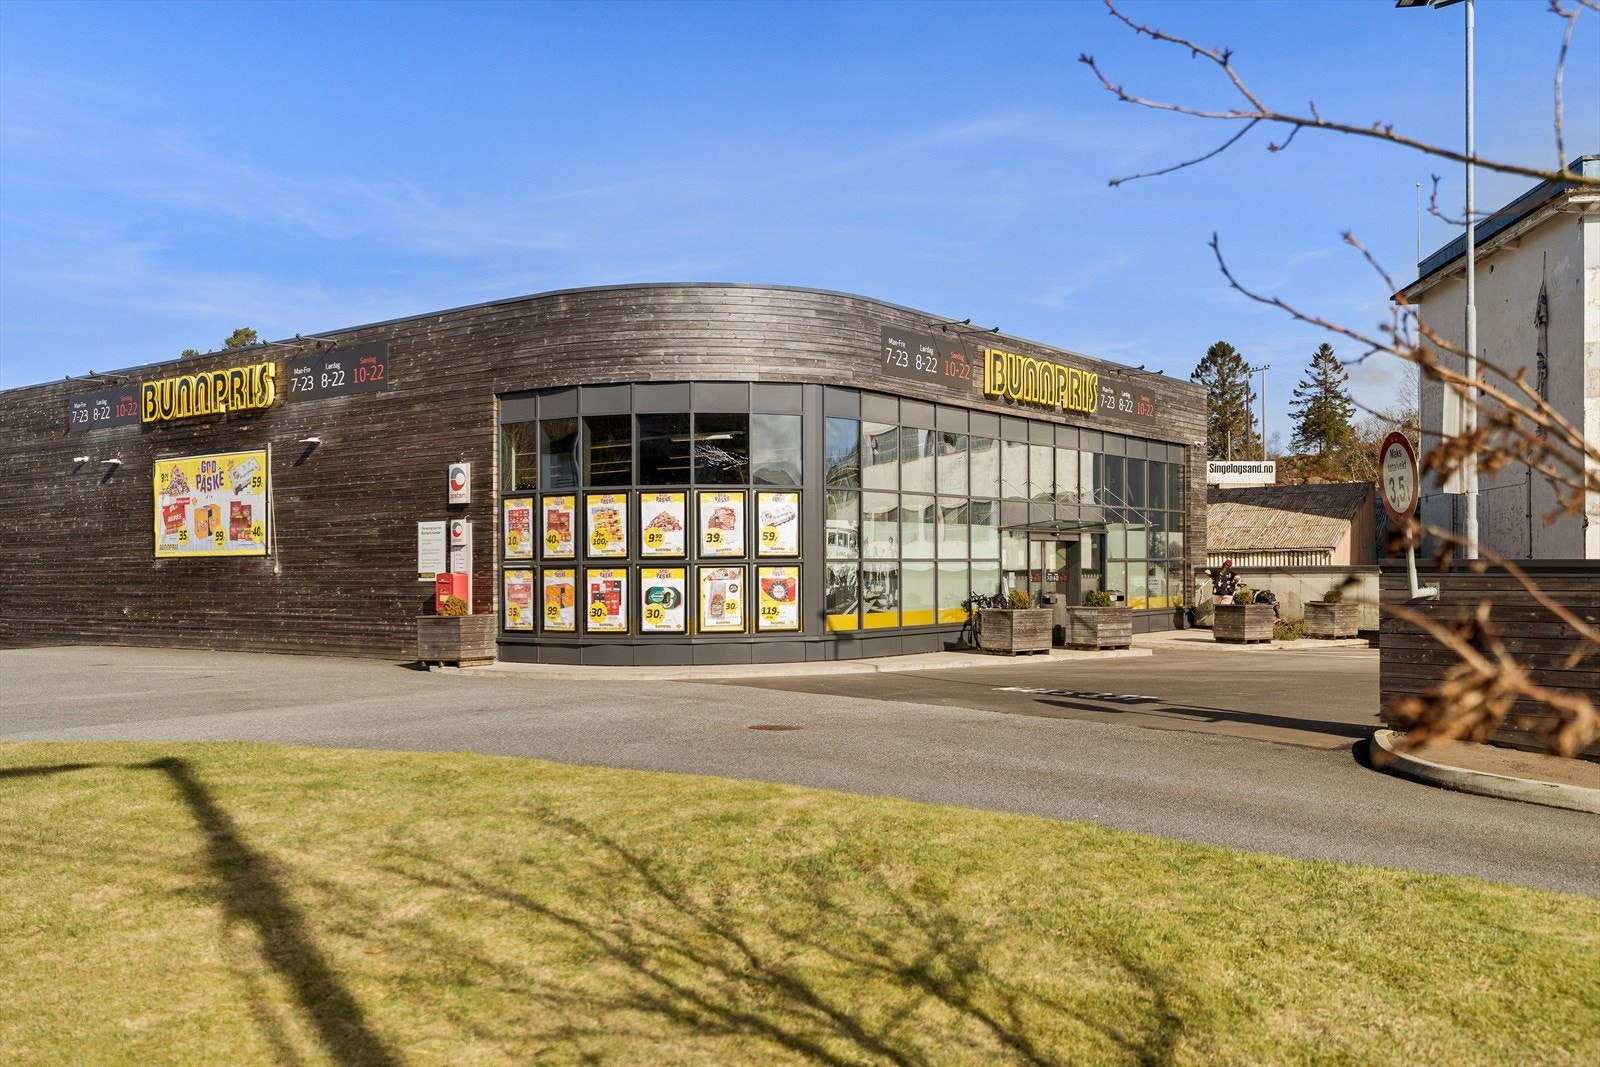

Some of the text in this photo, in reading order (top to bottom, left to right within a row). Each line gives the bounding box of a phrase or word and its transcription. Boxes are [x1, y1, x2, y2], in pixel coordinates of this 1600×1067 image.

[888, 337, 965, 363] Man-Fre Lørdag Søndag
[293, 356, 377, 375] Man-Fre Lørdag Søndag
[885, 347, 971, 380] 7-23 8-22 10-22
[291, 364, 384, 393] 7-23 8-22 10-22
[985, 349, 1099, 414] BUNNPRIS
[142, 362, 275, 422] BUNNPRIS
[72, 402, 138, 423] 7-23 8-22 10-22
[1100, 394, 1154, 417] 7-23 8-22 10-22
[1389, 448, 1402, 459] Maks
[1209, 463, 1273, 475] Singelogsand.no
[196, 471, 224, 493] PÅSKE
